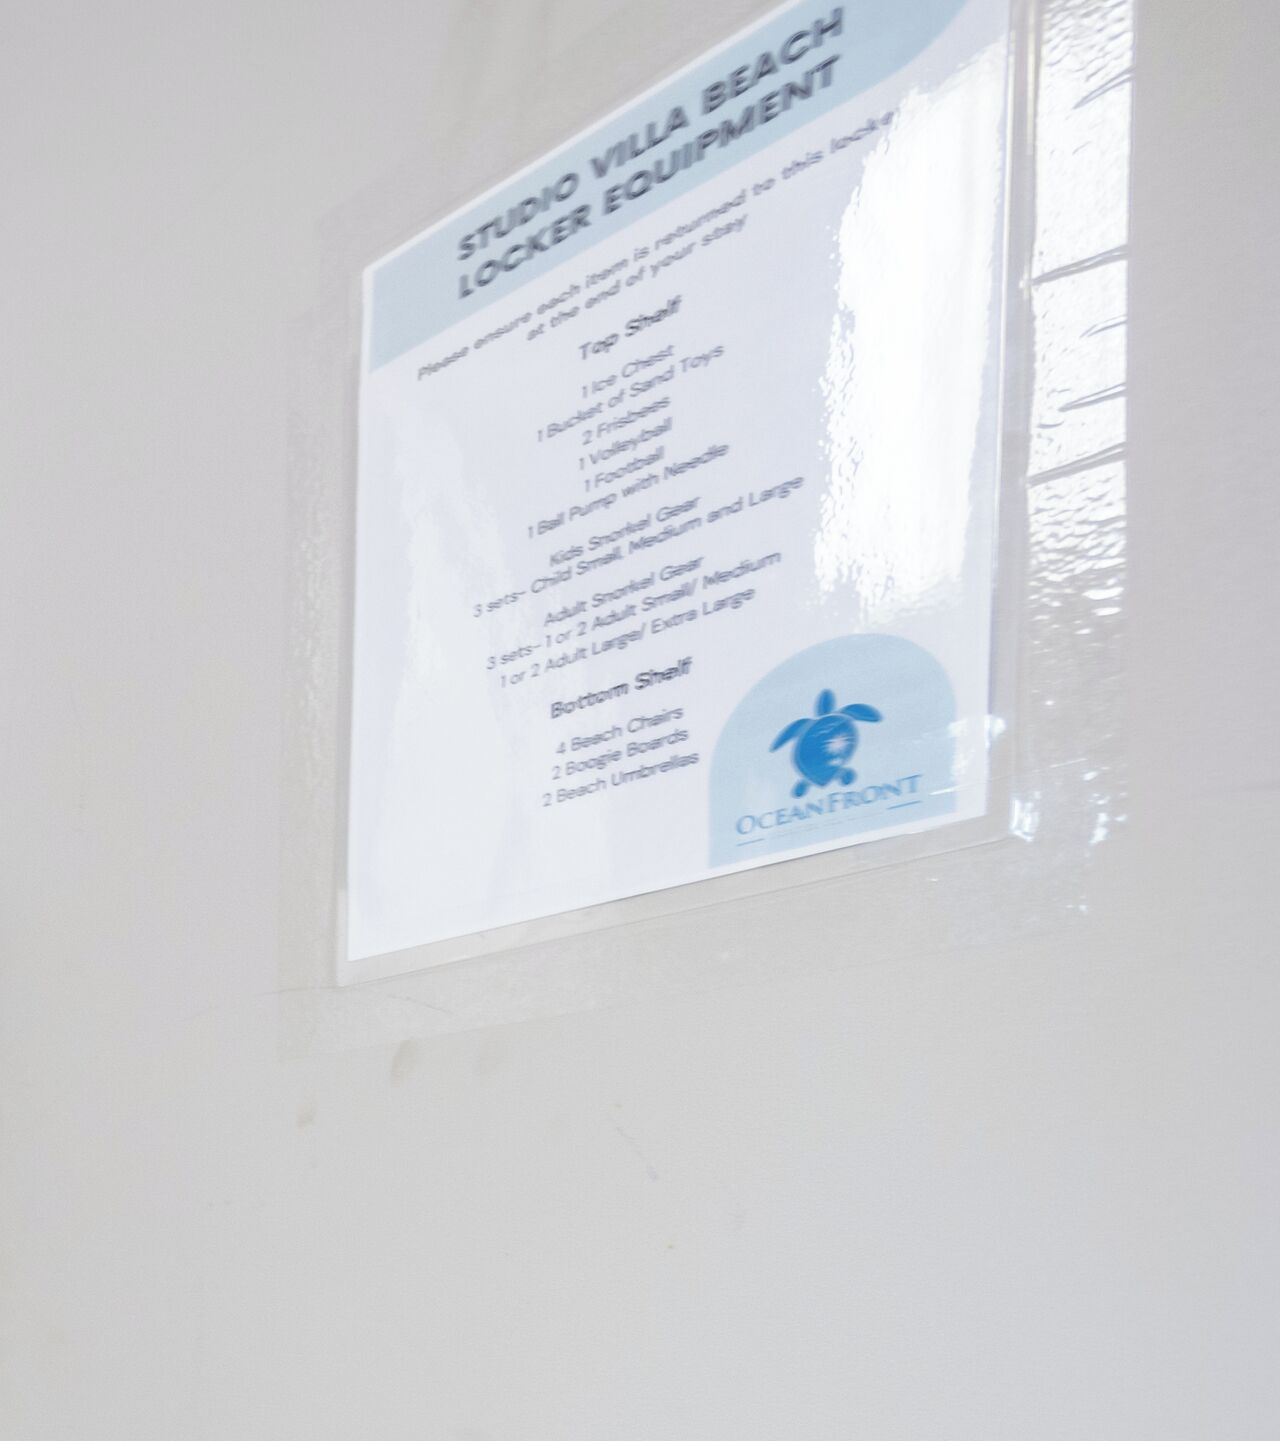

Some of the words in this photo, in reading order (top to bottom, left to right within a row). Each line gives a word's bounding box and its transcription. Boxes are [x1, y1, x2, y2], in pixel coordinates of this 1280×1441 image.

[457, 172, 580, 261] STUDIO
[590, 106, 689, 179] VILLA
[701, 6, 844, 115] BEACH
[458, 203, 592, 300] LOCKER
[602, 54, 842, 215] EQUIPMENT
[418, 345, 470, 380] Please
[473, 312, 532, 350] ensure
[536, 283, 581, 316] each
[585, 256, 629, 289] item
[633, 246, 650, 262] is
[653, 188, 747, 251] returned
[752, 177, 776, 196] to
[781, 149, 824, 180] this
[527, 323, 545, 341] at
[550, 306, 580, 330] the
[584, 284, 619, 309] end
[626, 266, 646, 287] of
[650, 242, 697, 277] your
[701, 214, 748, 247] stay
[578, 333, 619, 361] Top
[624, 295, 683, 337] Shelf
[546, 402, 603, 439] Bucket
[608, 389, 625, 408] of
[629, 365, 675, 398] Sand
[679, 345, 725, 373] Toys
[591, 375, 617, 394] Ice
[621, 345, 675, 378] Chest
[582, 429, 593, 446] 2
[596, 397, 671, 438] Frisbees
[589, 416, 673, 465] Volleyball
[537, 511, 565, 535] Ball
[569, 493, 618, 521] Pump
[621, 472, 659, 498] with
[663, 444, 730, 480] Needle
[594, 446, 665, 488] Football
[473, 603, 483, 618] 3
[530, 565, 573, 594] Child
[628, 515, 703, 555] Medium
[706, 497, 744, 525] and
[748, 476, 805, 507] Large
[549, 545, 584, 567] Kids
[588, 513, 651, 551] Snorkel
[655, 496, 701, 523] Gear
[487, 656, 496, 671] 3
[555, 631, 571, 645] or
[577, 622, 588, 638] 2
[591, 603, 637, 632] Adult
[641, 578, 698, 613] Small/
[702, 552, 782, 590] Medium
[543, 600, 588, 628] Adult
[591, 572, 655, 609] Snorkel
[659, 555, 705, 582] Gear
[510, 671, 526, 686] or
[531, 662, 541, 679] 2
[544, 647, 588, 674] Adult
[591, 622, 647, 656] Large/
[650, 607, 698, 636] Extra
[702, 588, 756, 616] Large
[550, 682, 629, 720] Bottom
[634, 656, 693, 692] Shelf
[552, 765, 561, 780] 2
[565, 748, 622, 776] Boogie
[626, 728, 689, 756] Boards
[555, 740, 566, 756] 4
[570, 725, 623, 752] Beach
[626, 705, 684, 733] Chairs
[542, 793, 553, 807] 2
[556, 777, 608, 804] Beach
[611, 751, 700, 786] Umbrellas
